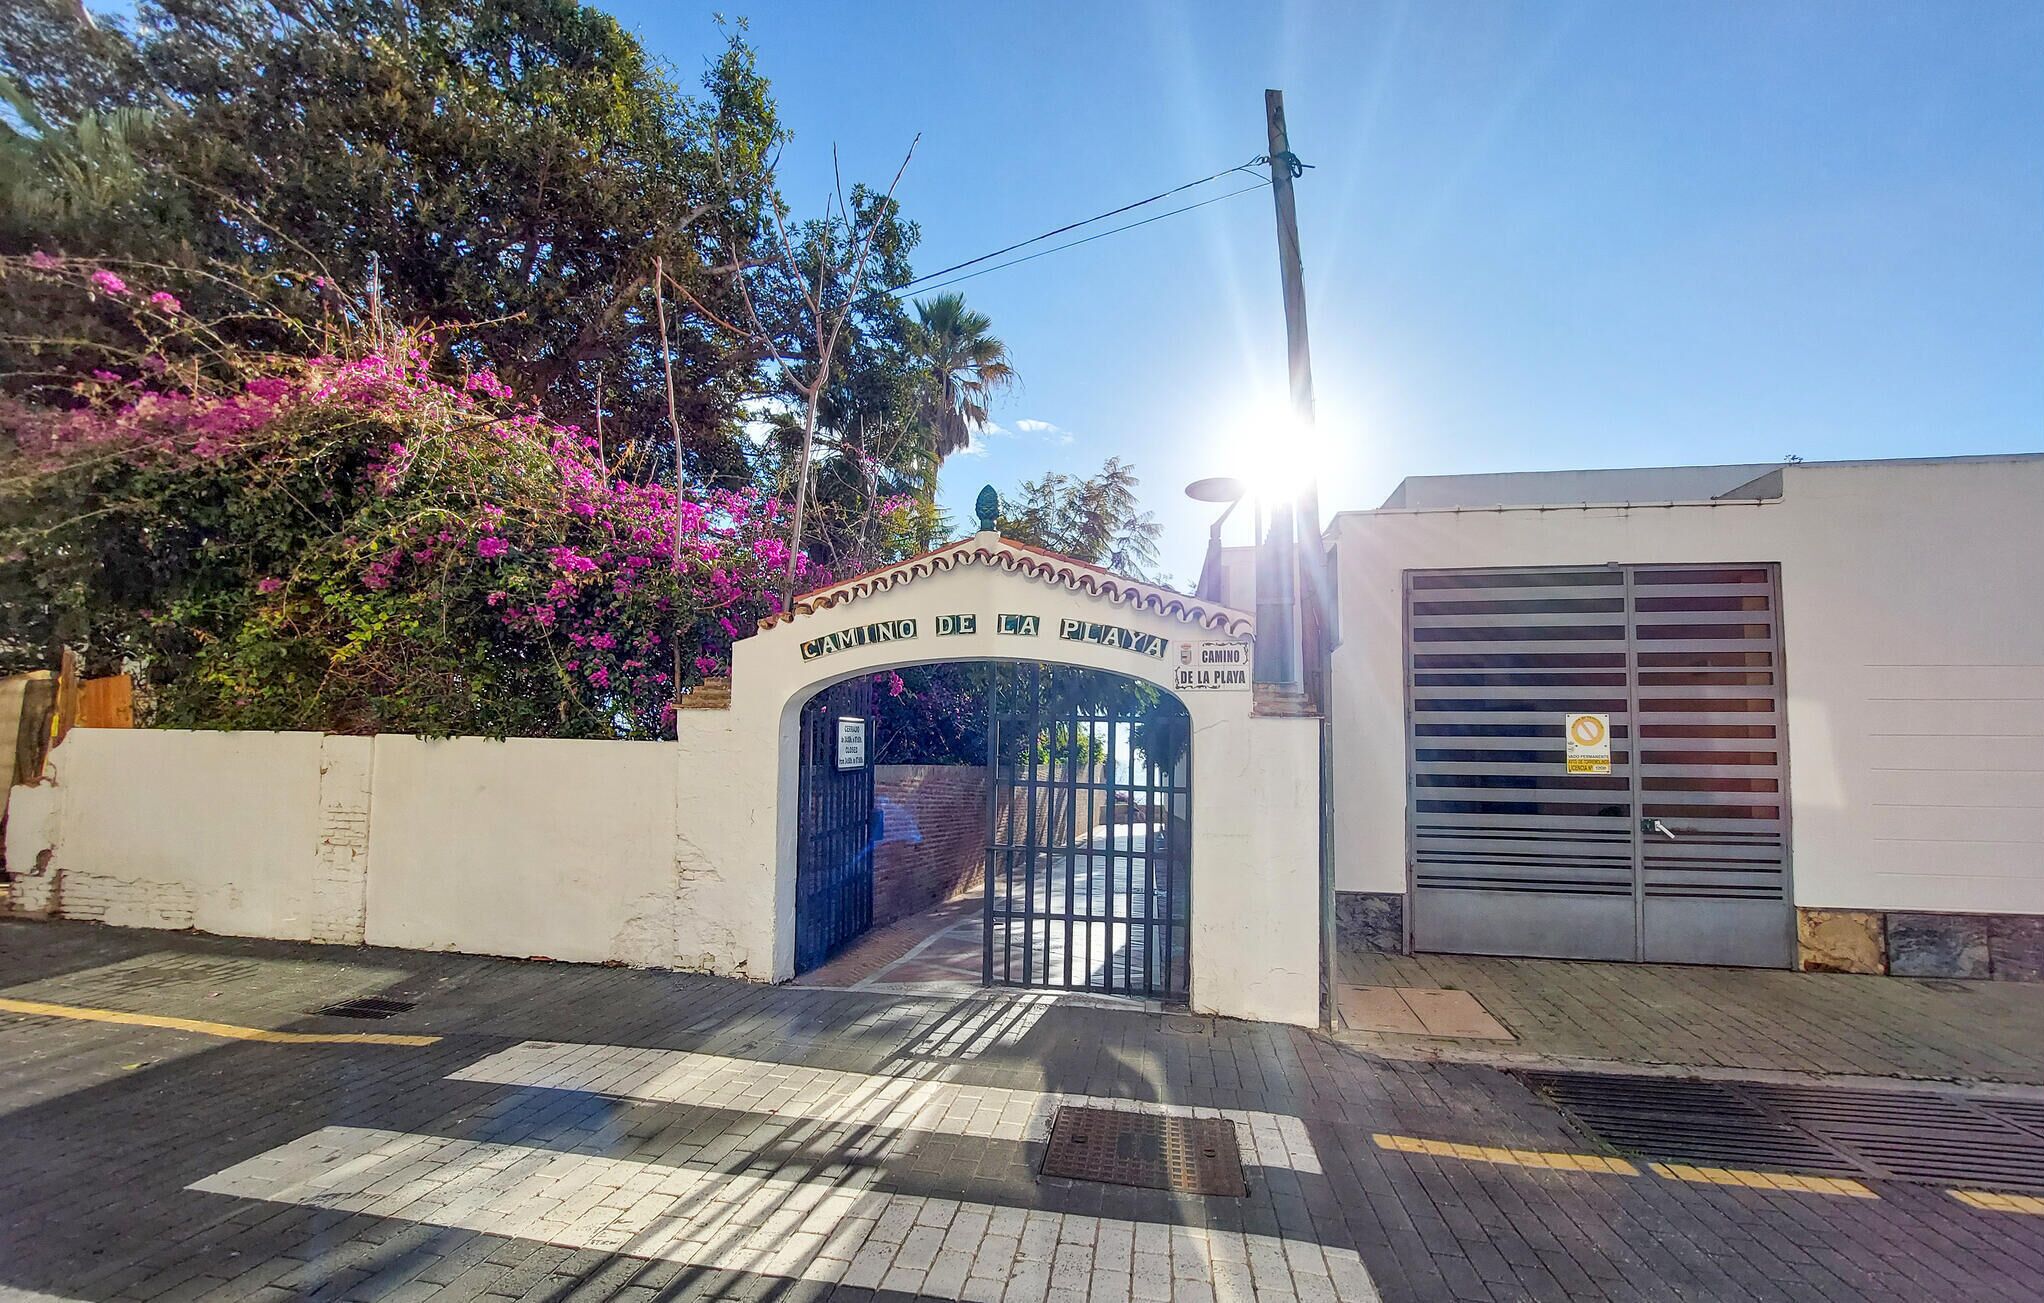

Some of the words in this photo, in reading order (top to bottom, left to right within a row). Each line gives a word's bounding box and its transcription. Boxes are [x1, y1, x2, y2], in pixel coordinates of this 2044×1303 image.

[802, 619, 917, 659] CAMINO
[937, 615, 975, 636] DE
[999, 614, 1038, 636] LA
[1060, 618, 1167, 659] PLAYA
[1201, 650, 1240, 664] CAMINO
[1180, 670, 1194, 684] DE
[1197, 670, 1210, 684] LA
[1214, 670, 1246, 684] PLAYA
